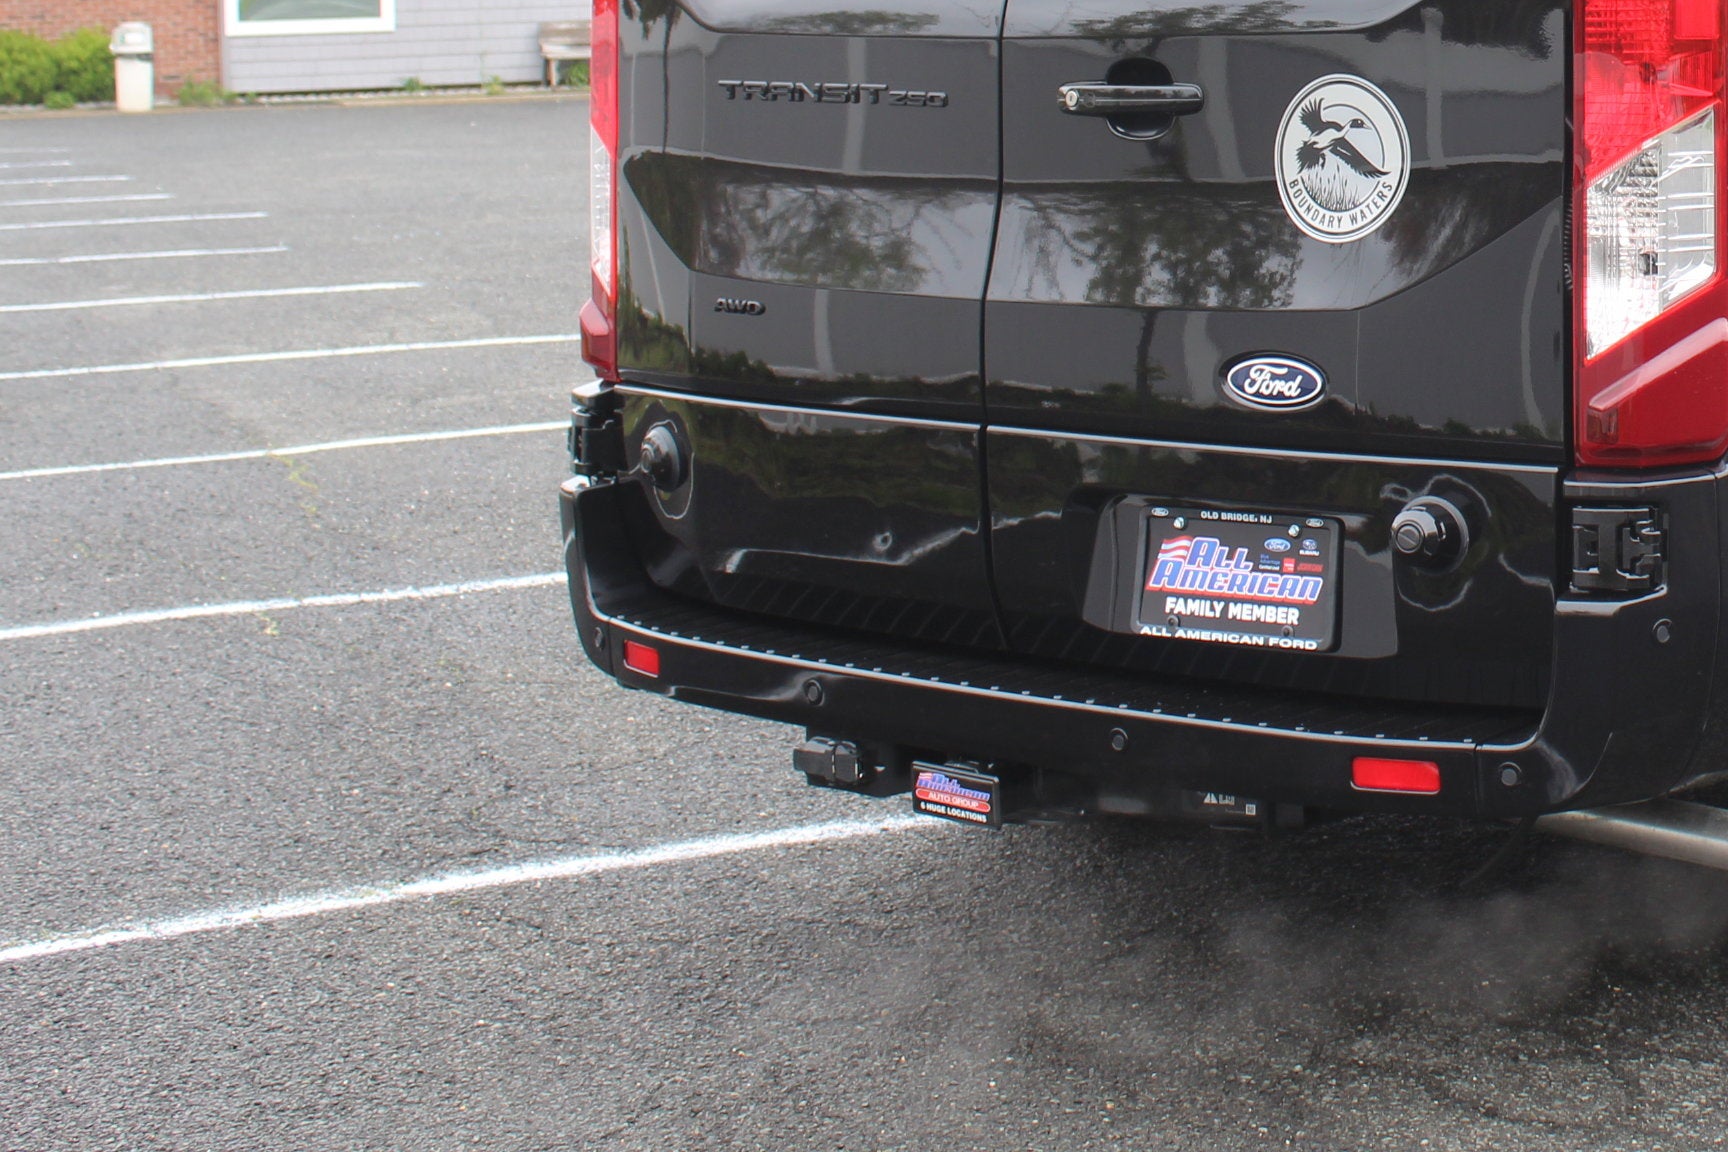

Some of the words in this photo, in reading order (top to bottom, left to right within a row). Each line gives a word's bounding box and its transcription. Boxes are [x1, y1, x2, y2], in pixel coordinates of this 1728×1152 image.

[718, 80, 889, 104] TRANSIT
[888, 90, 949, 108] 250
[1289, 179, 1344, 228] BOUNDARY
[1349, 181, 1393, 227] WATERS
[714, 297, 767, 316] AWD
[1244, 364, 1303, 397] Ford
[1200, 510, 1219, 520] OLD
[1259, 515, 1273, 524] NJ
[1165, 596, 1226, 620] FAMILY
[1227, 602, 1300, 626] MEMBER
[1139, 625, 1172, 638] ALL
[1174, 628, 1265, 647] AMERICAN
[1268, 637, 1319, 651] FORD
[926, 802, 946, 815] HUGE
[947, 807, 988, 823] LOCATIONS
[928, 791, 951, 803] AUTO
[951, 794, 979, 808] GROUP
